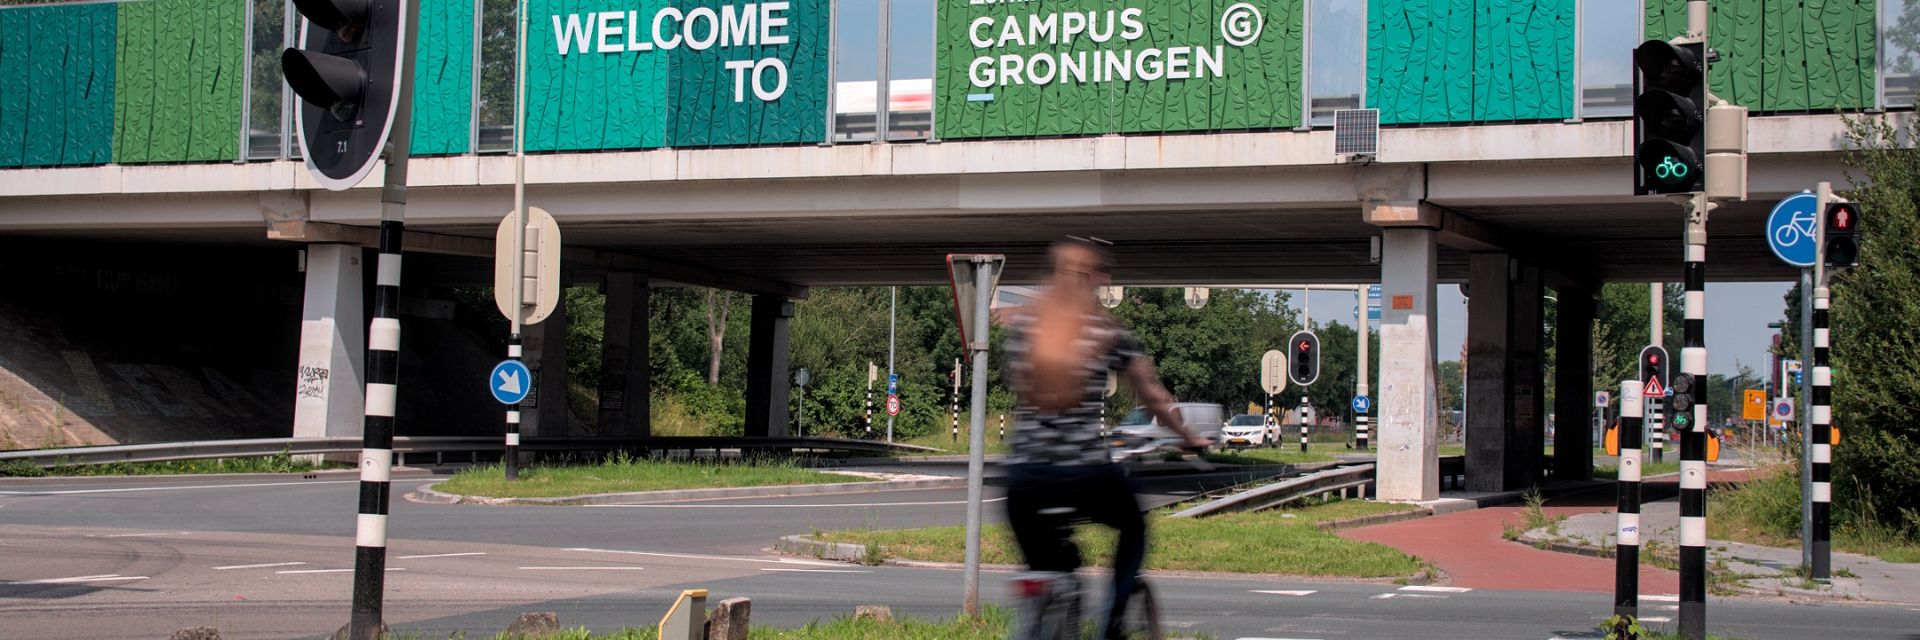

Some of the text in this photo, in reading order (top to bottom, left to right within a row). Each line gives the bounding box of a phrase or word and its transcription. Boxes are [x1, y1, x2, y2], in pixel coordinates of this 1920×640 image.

[552, 2, 790, 56] WELCOME
[969, 7, 1144, 48] CAMPUS
[725, 57, 788, 103] TO
[968, 45, 1224, 88] GRONINGEN
[337, 140, 348, 153] 7.1
